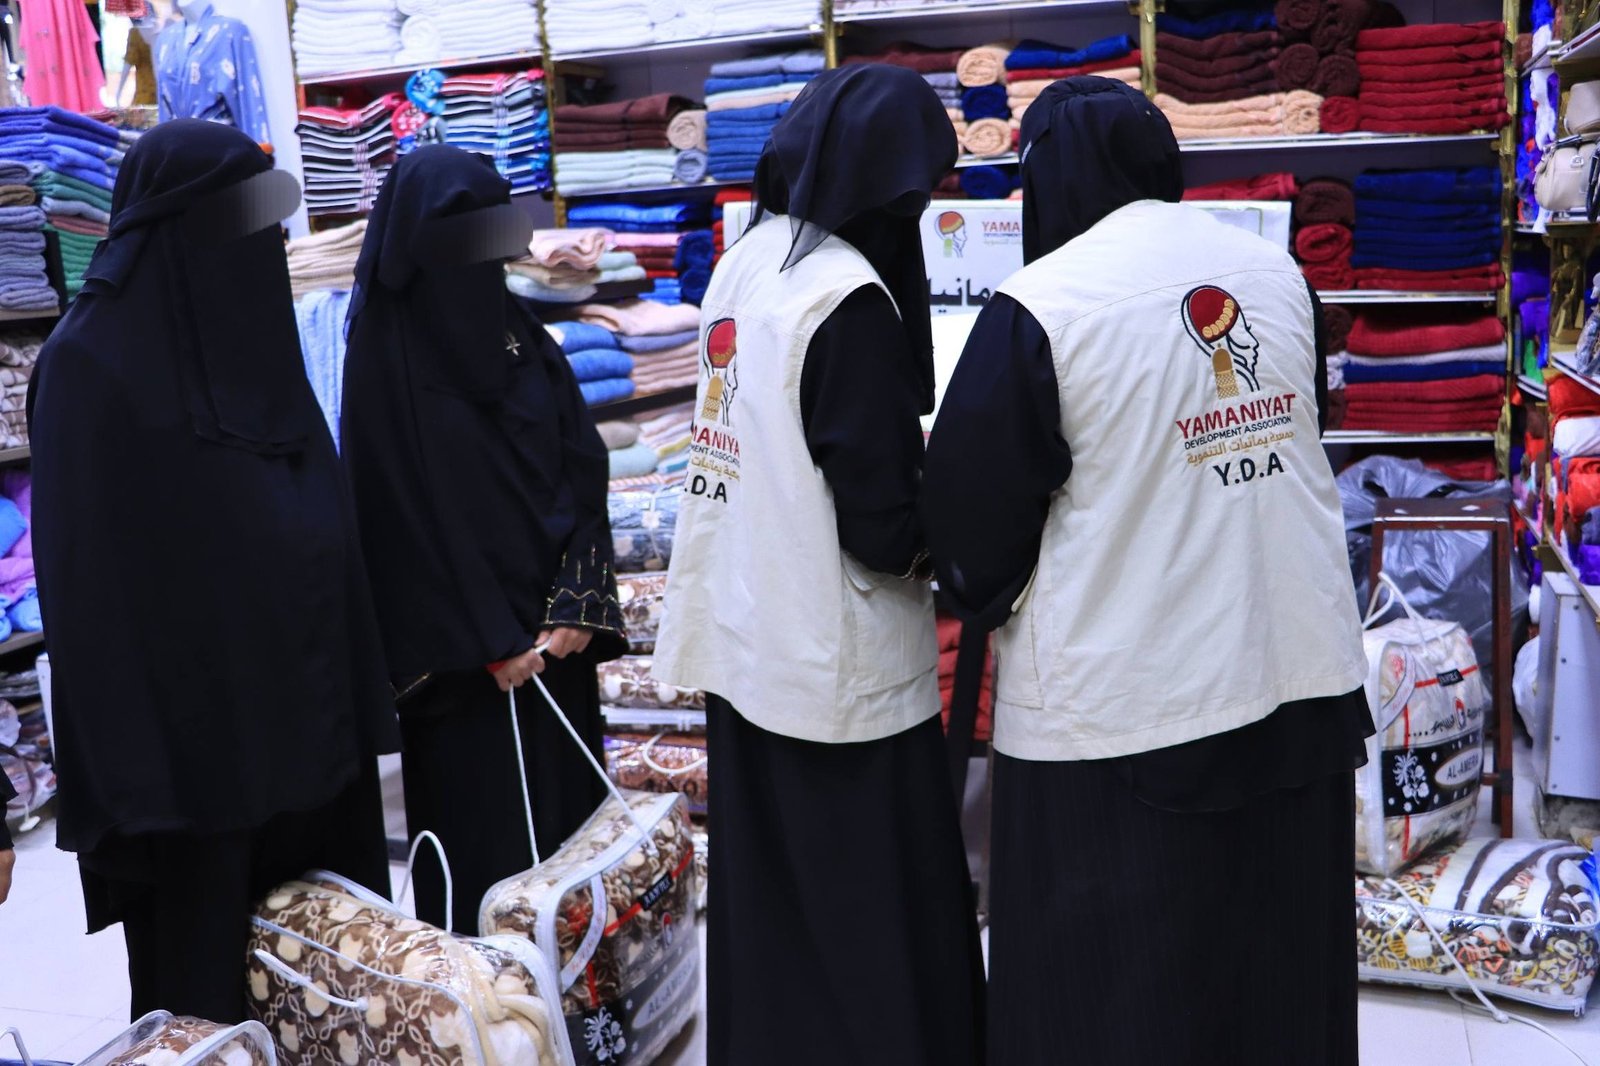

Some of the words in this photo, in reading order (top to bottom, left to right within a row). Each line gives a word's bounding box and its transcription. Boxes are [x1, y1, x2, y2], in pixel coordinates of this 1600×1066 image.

[982, 221, 1021, 232] YAMA
[1176, 394, 1295, 439] YAMANIYAT
[1184, 427, 1241, 450] DEVELOPMENT
[1244, 416, 1292, 434] ASSOCIATION
[1229, 434, 1268, 453] يمانيات
[1187, 441, 1227, 467] التنموية
[1213, 452, 1284, 486] Y.D.A
[684, 474, 728, 503] .D.A
